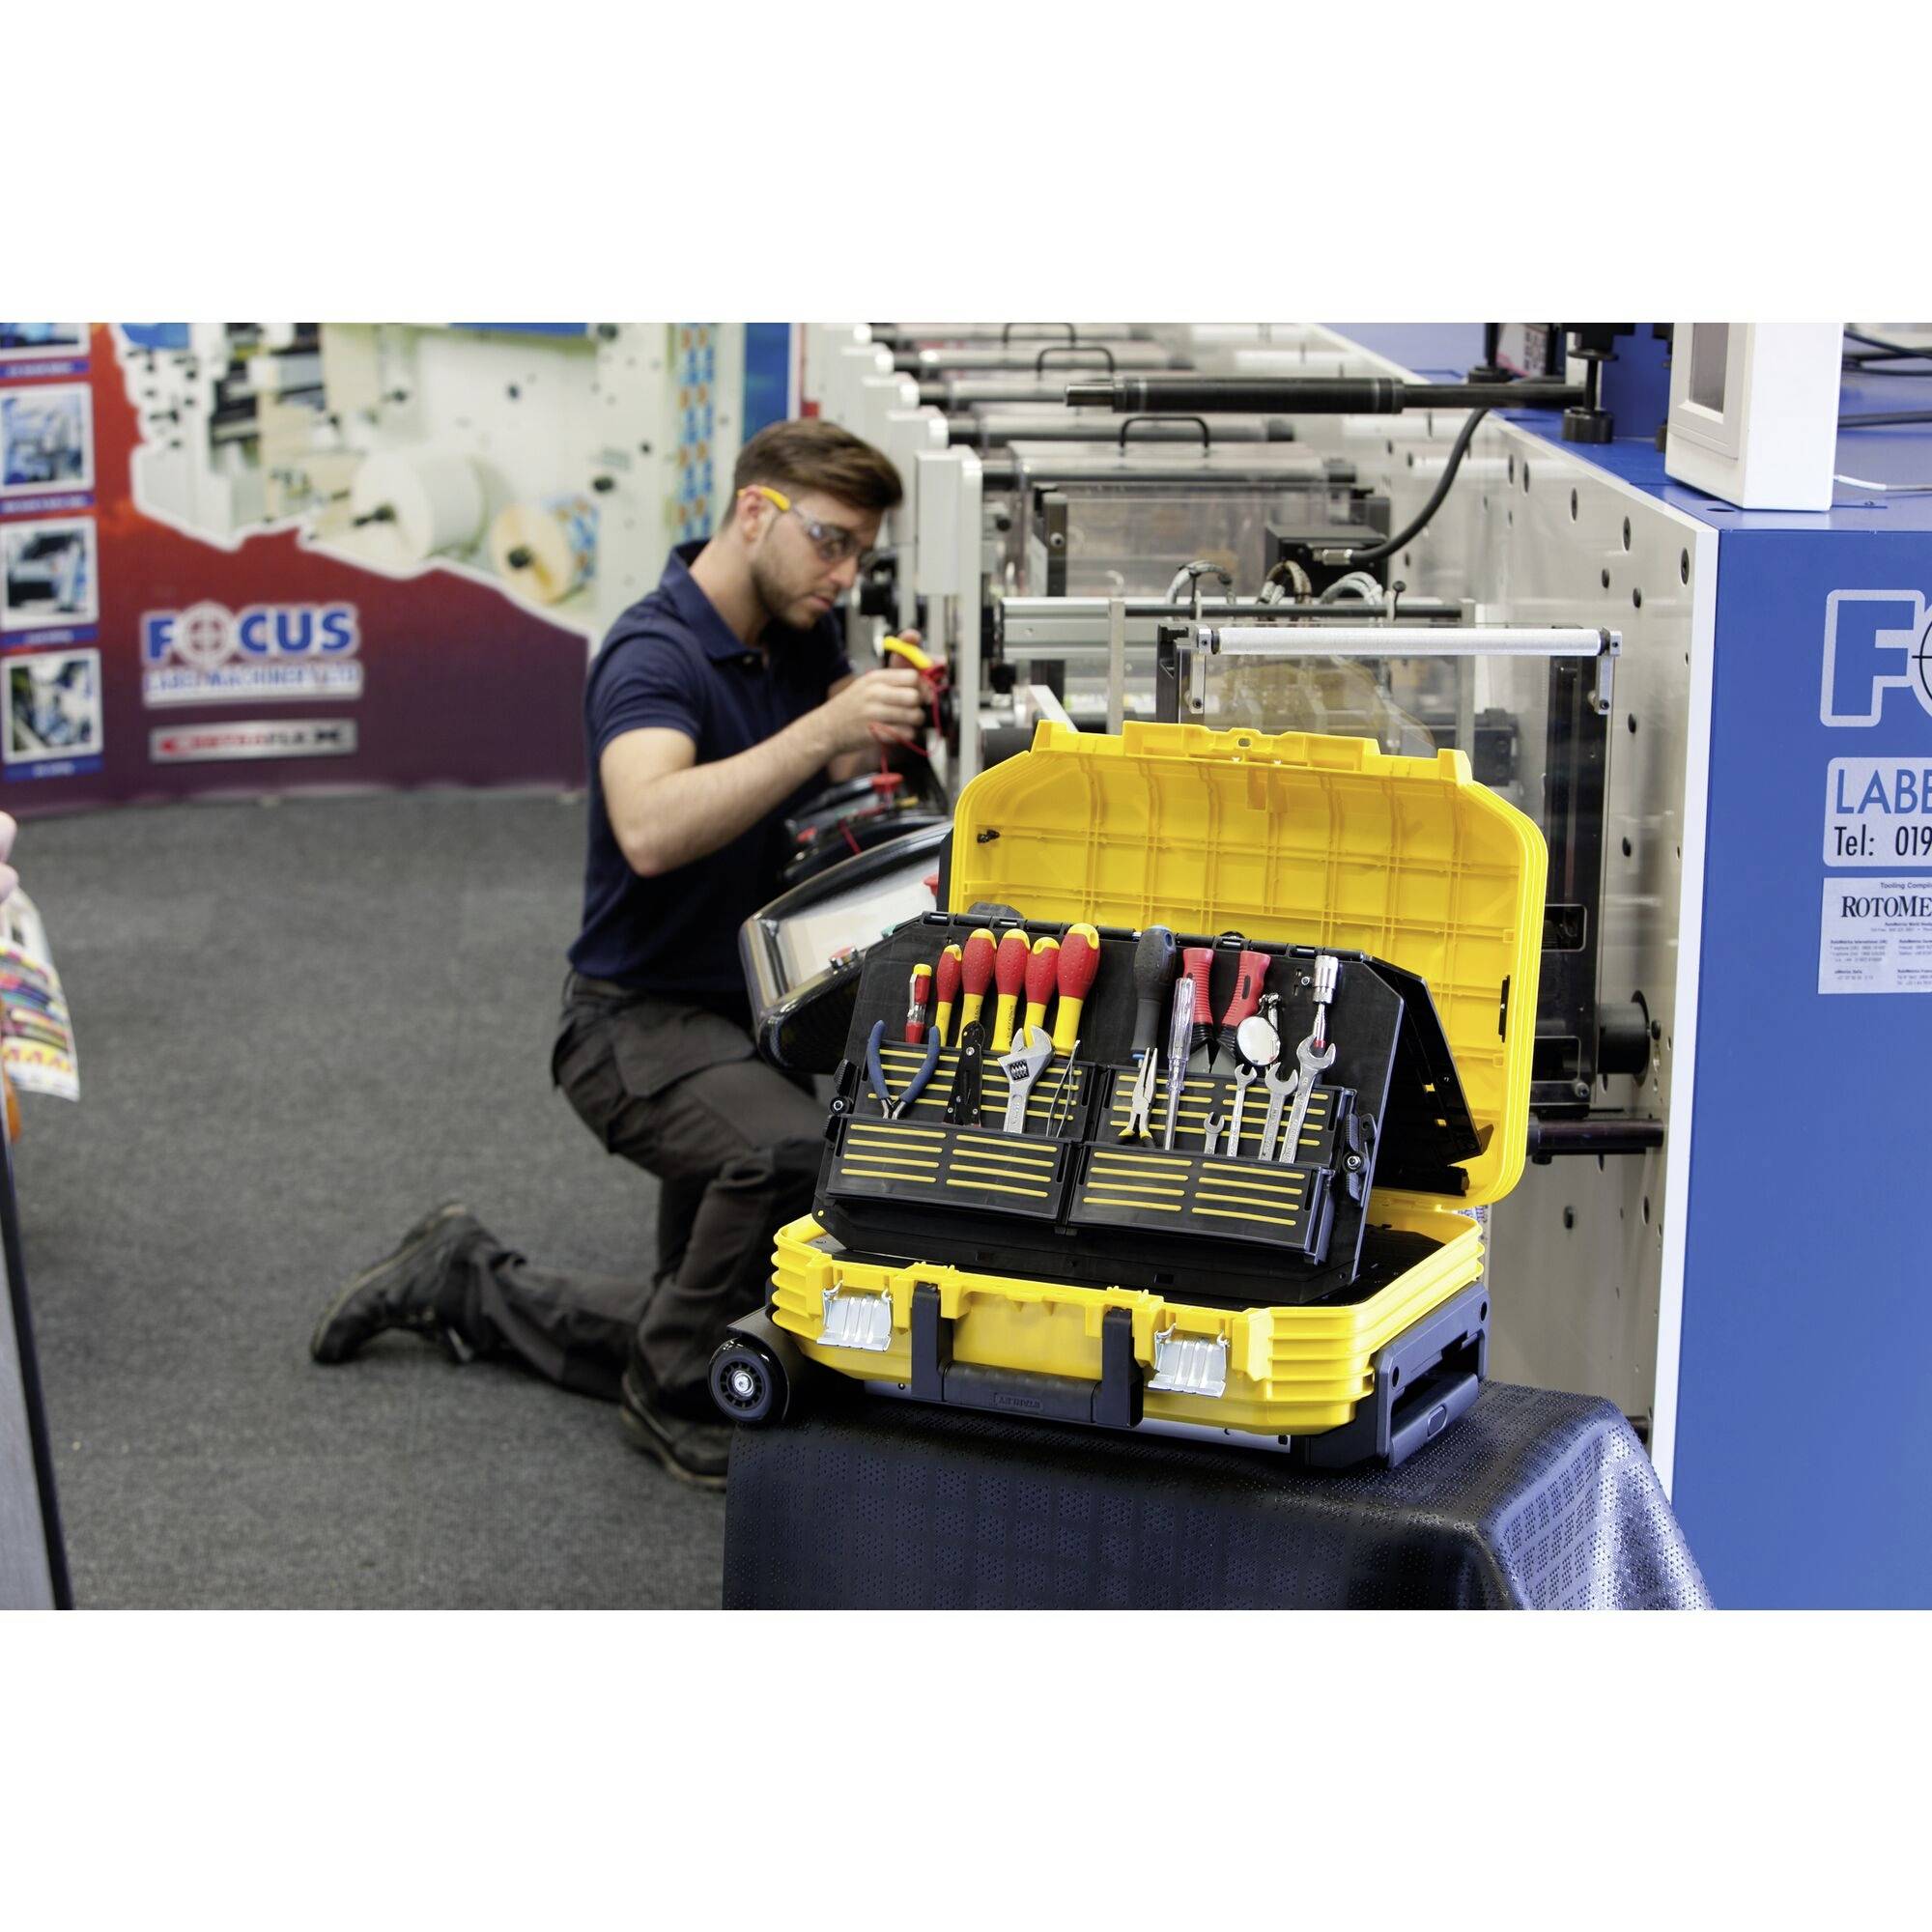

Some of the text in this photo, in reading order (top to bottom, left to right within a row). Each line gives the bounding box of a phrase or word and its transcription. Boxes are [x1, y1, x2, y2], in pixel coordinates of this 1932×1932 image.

[147, 600, 354, 667] FOCUS
[1820, 589, 1932, 727] F
[1834, 824, 1932, 856] Tel: 019
